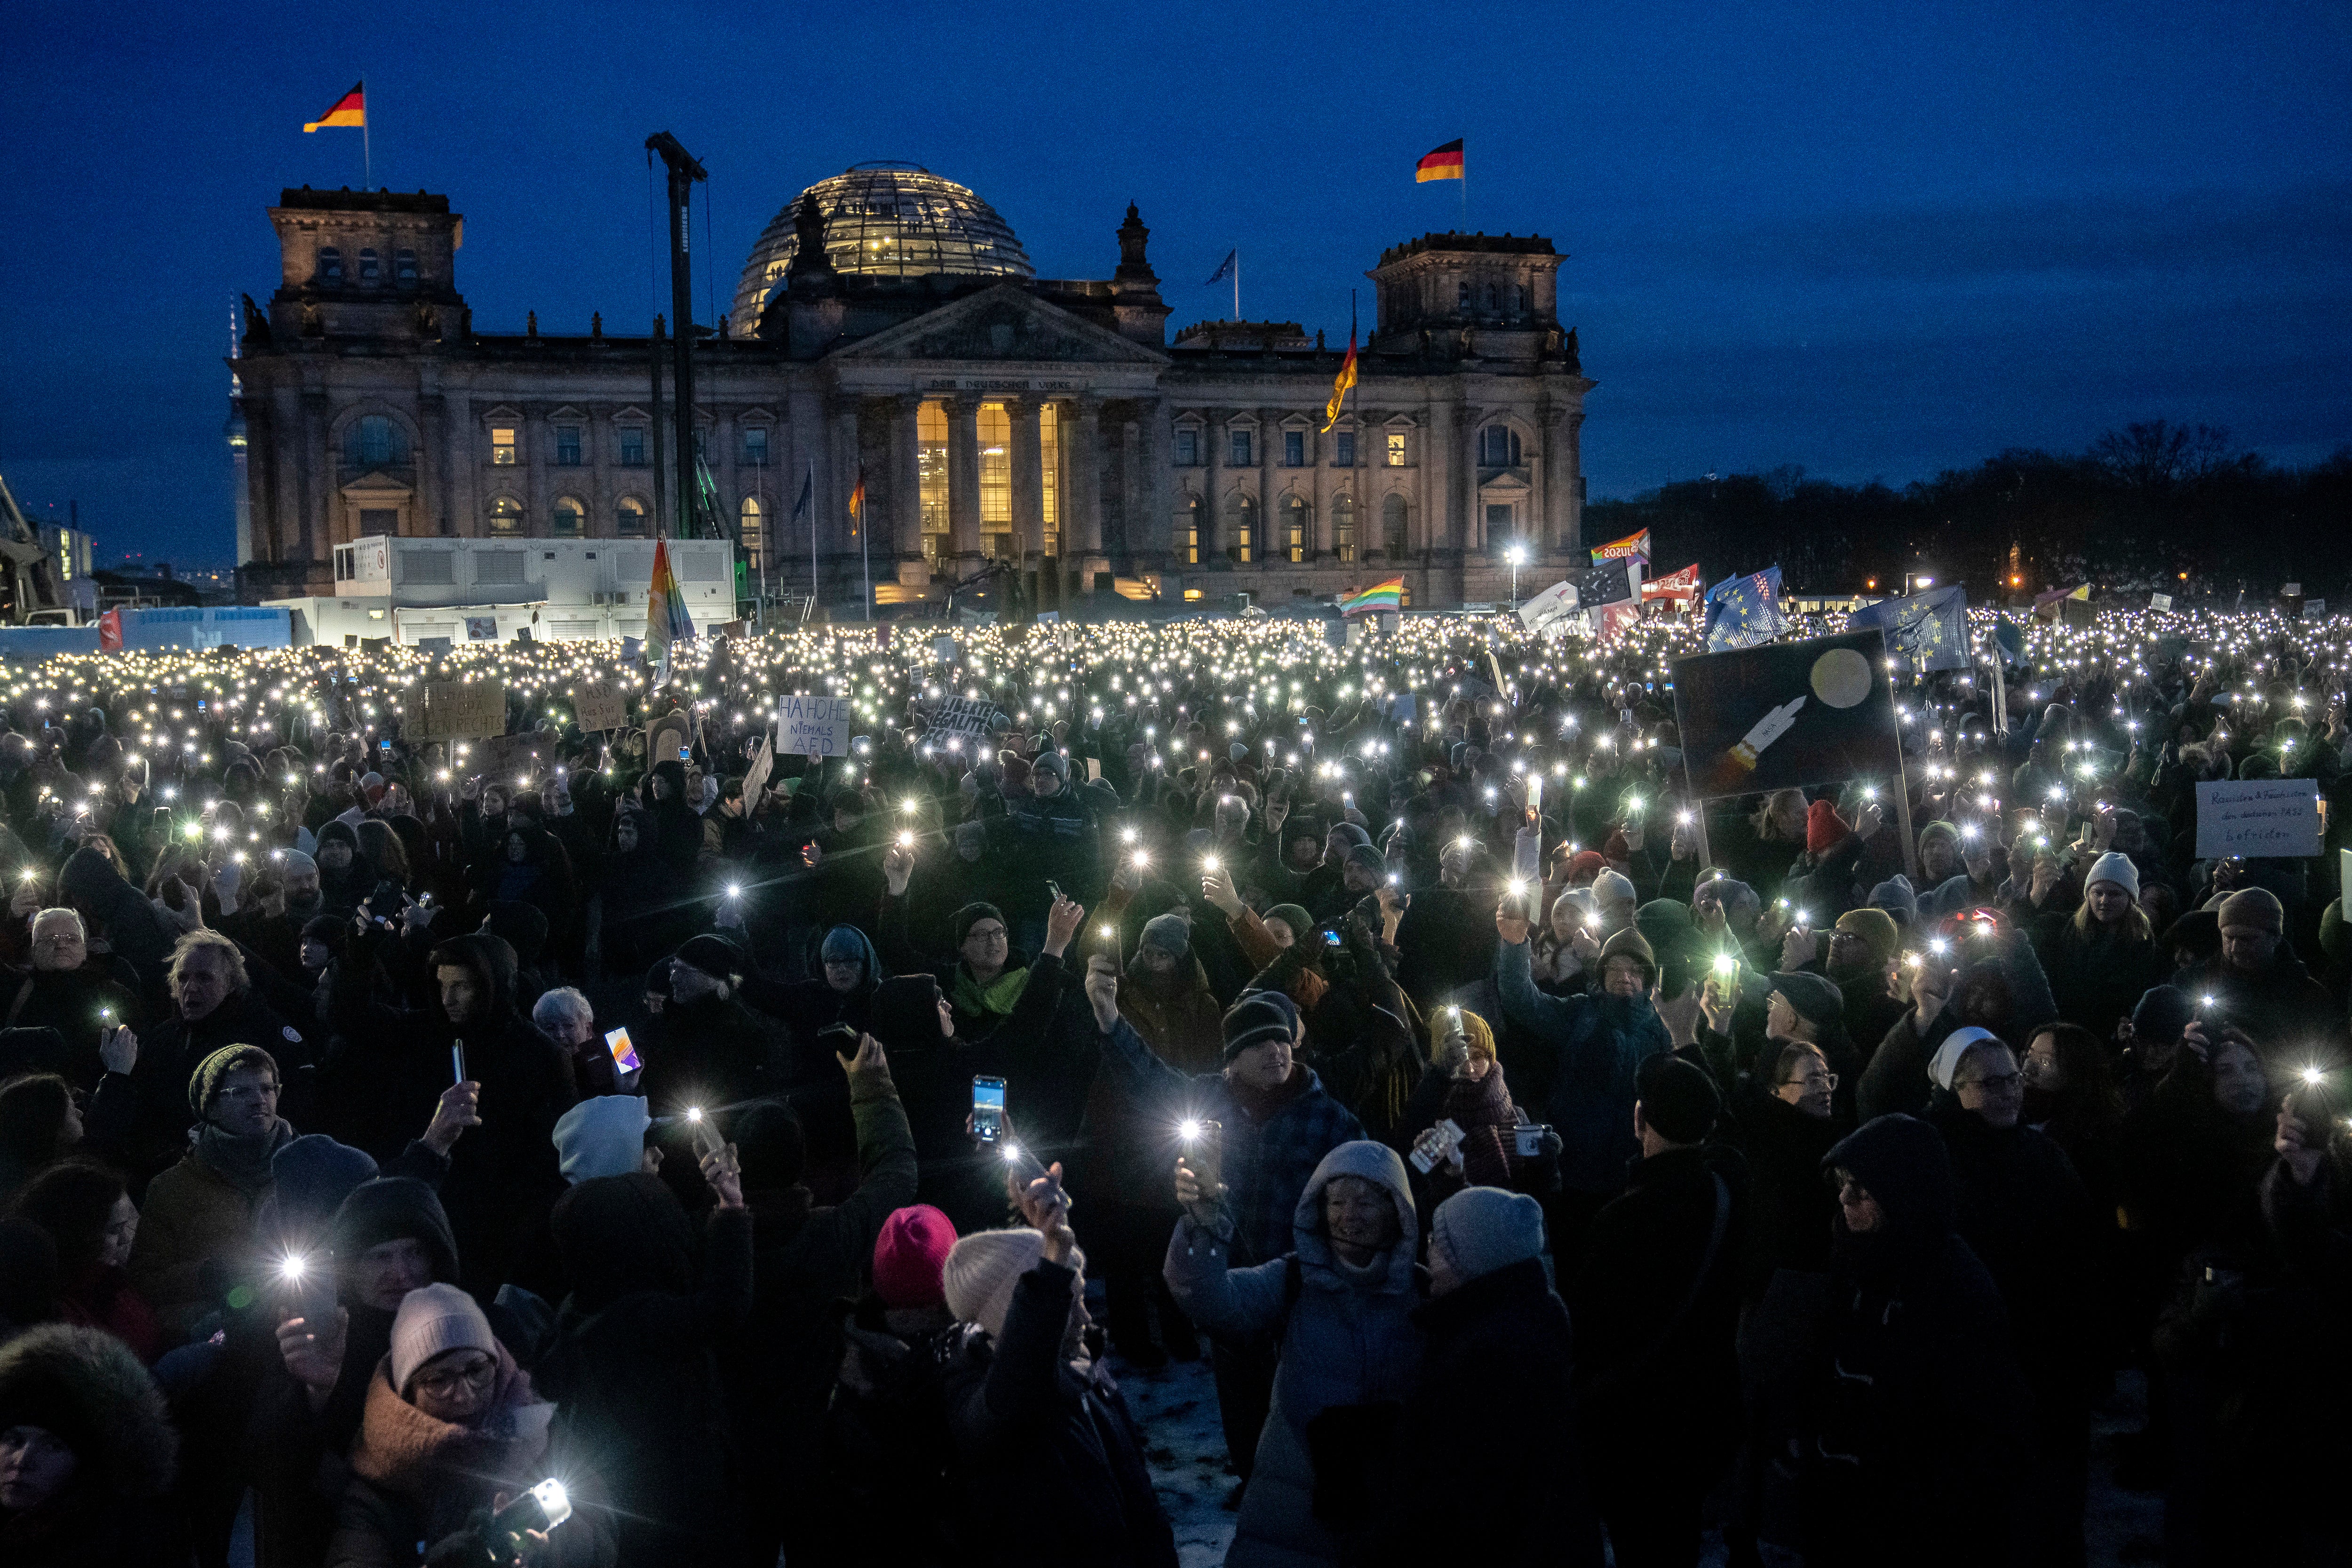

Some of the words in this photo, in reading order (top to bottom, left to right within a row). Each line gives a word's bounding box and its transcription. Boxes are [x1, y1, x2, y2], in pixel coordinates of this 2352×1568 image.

[966, 380, 1029, 389] DEUTSCHEN
[1039, 381, 1071, 390] VOLKE
[1808, 616, 1826, 628] FCK
[458, 700, 484, 716] OPA
[456, 715, 502, 733] RECHTS
[793, 737, 833, 755] AFD
